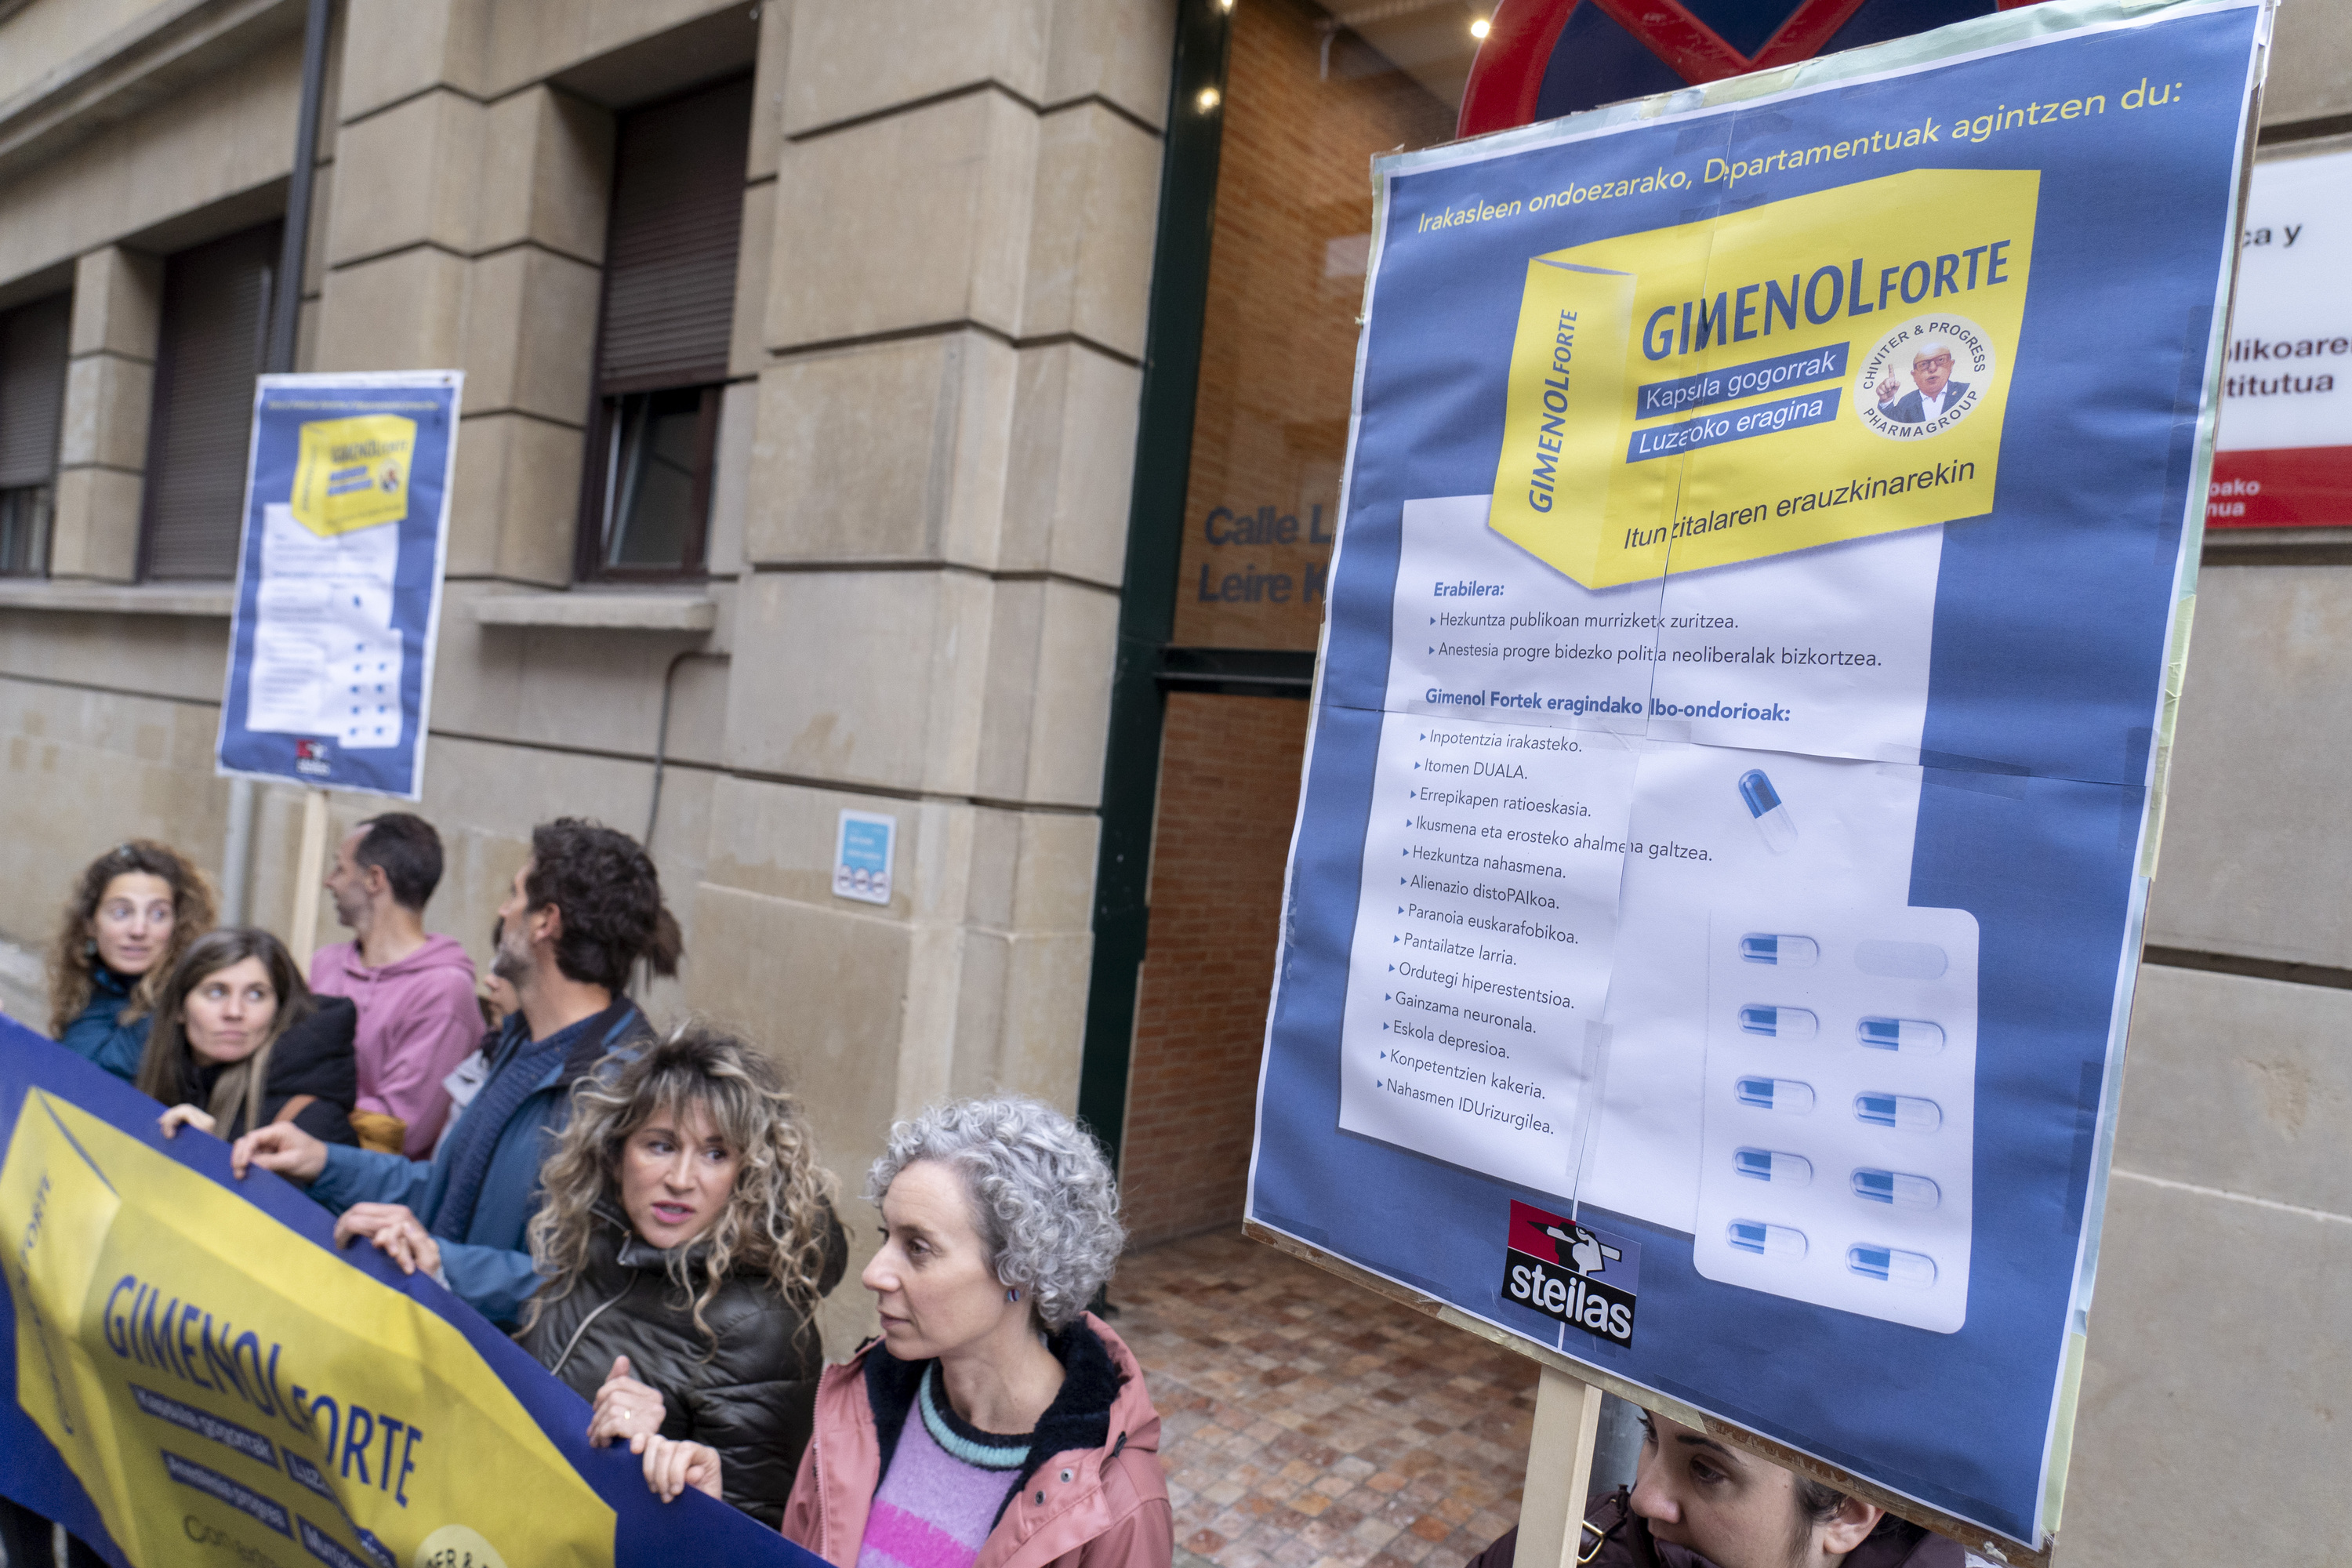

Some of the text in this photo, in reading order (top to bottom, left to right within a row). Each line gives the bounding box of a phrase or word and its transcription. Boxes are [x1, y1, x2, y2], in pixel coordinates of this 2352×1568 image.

[1419, 201, 1521, 232] Irakasleen
[1529, 167, 1691, 211] ondoezarako,
[1952, 96, 2105, 142] agintzen
[2122, 78, 2182, 109] du:
[2284, 223, 2302, 249] y
[1863, 322, 1985, 390] CHIVITER & PROGRESS
[2229, 337, 2352, 363] likoare
[1728, 350, 1836, 397] gogorrak
[1737, 397, 1822, 430] eragina
[1864, 390, 1977, 437] PHARMAGROUP
[1777, 459, 1974, 517] erauzkinarekin
[1204, 506, 1300, 546] Calle
[1199, 563, 1292, 604] Leire
[1434, 580, 1504, 596] Erabilera:
[1440, 612, 1504, 626] Hezkuntza
[1510, 612, 1579, 630] publikoan
[1671, 613, 1738, 628] zuritzea.
[1439, 642, 1498, 656] Anestesia
[1503, 648, 1550, 662] progre
[1555, 643, 1612, 659] bidezko
[1673, 646, 1775, 663] neoliberalak
[1782, 647, 1881, 666] bizkortzea.
[1426, 688, 1485, 706] Gimenol
[1491, 691, 1542, 709] Fortek
[1548, 695, 1642, 716] eragindako
[1430, 730, 1581, 752] Inpotentzia irakasteko.
[1425, 758, 1527, 779] Itomen DUALA.
[1421, 787, 1591, 817] Errepikapen ratioeskasia.
[1417, 815, 1476, 836] Ikusmena
[1481, 826, 1502, 839] eta
[1508, 830, 1569, 846] erosteko
[1649, 840, 1711, 861] galtzea.
[1414, 845, 1566, 878] Hezkuntza nahasmena.
[1410, 875, 1559, 909] Alienazio distoPAIkoa.
[1409, 903, 1577, 944] Paranoia euskarafobikoa.
[1404, 932, 1516, 965] Pantailatze larria.
[1399, 962, 1573, 1008] Ordutegi hiperestentsioa.
[1396, 991, 1536, 1033] Gainzama neuronala.
[1394, 1020, 1509, 1058] Eskola depresioa.
[1391, 1049, 1544, 1099] Konpetentzien kakeria.
[1387, 1078, 1553, 1134] Nahasmen IDUrizurgilea.
[1510, 1264, 1632, 1339] steilas
